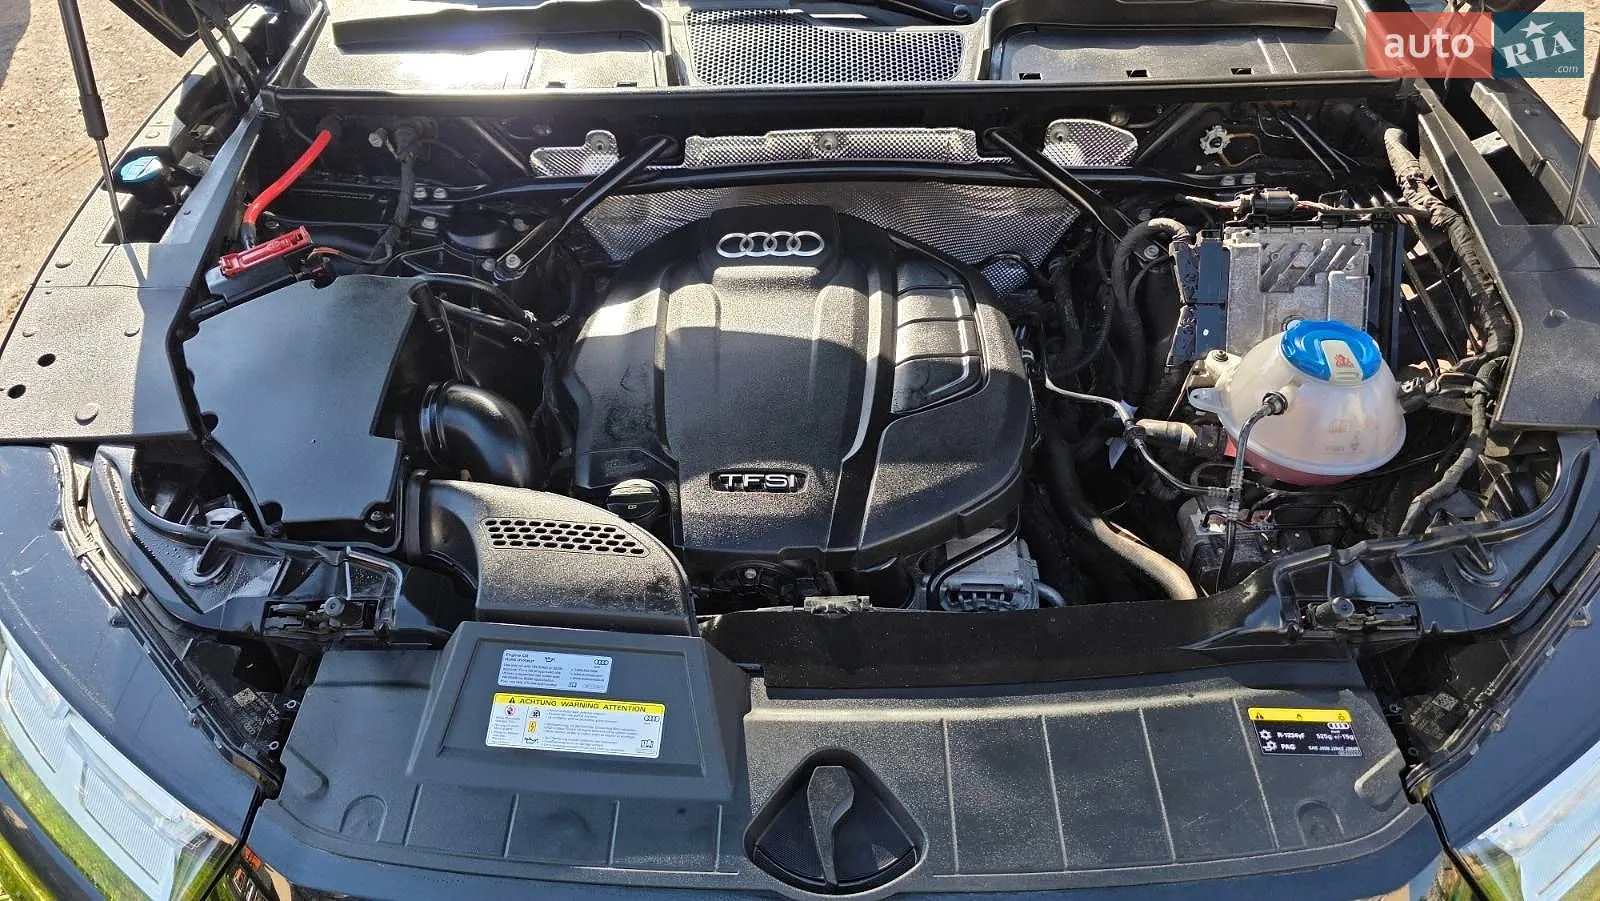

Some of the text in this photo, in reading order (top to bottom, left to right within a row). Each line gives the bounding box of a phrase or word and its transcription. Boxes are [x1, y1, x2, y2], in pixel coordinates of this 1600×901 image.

[719, 473, 795, 487] TFSI
[519, 698, 647, 713] ACHTUNG WARNING ATTENTION
